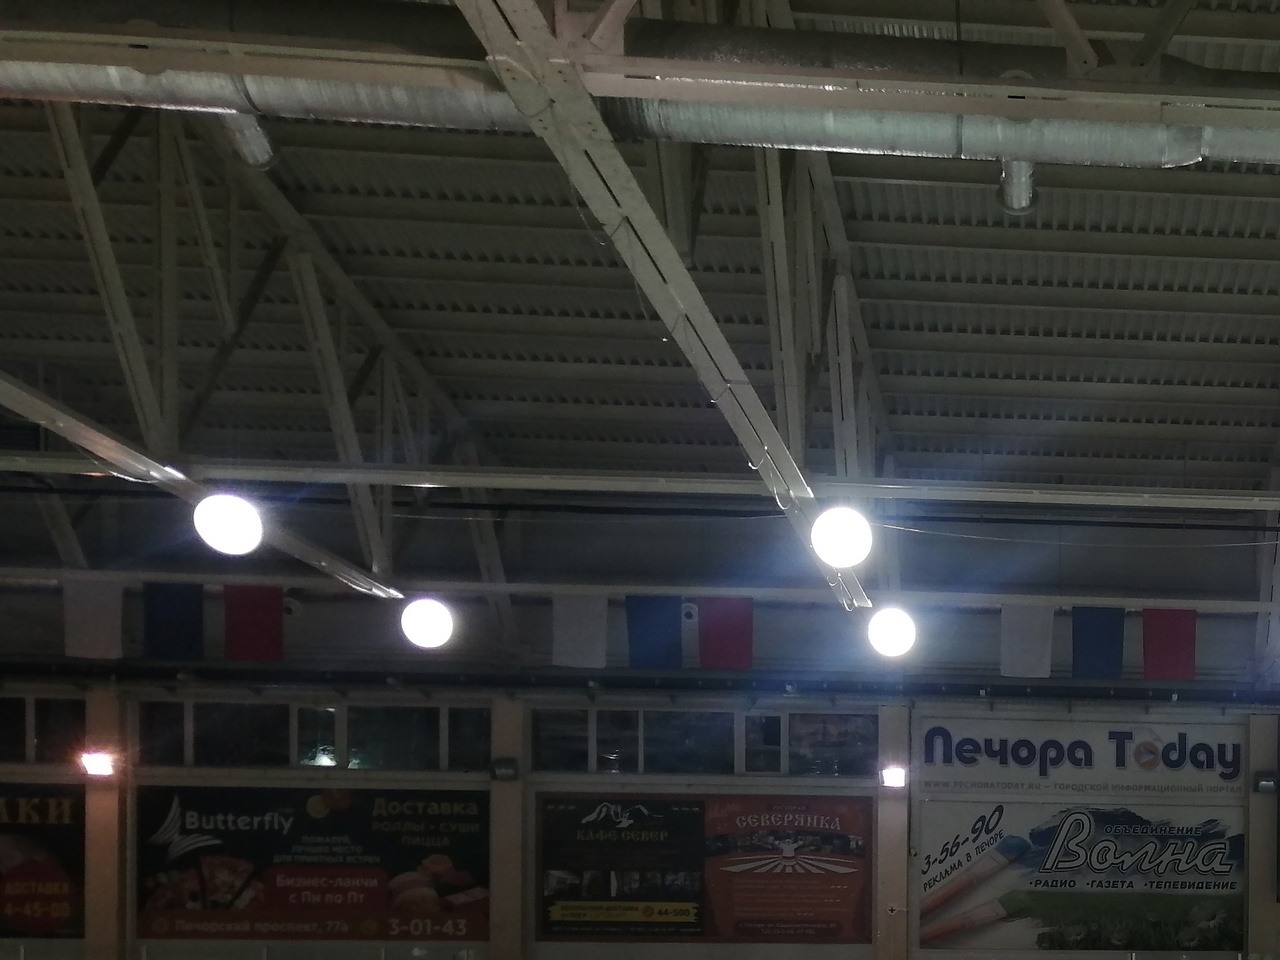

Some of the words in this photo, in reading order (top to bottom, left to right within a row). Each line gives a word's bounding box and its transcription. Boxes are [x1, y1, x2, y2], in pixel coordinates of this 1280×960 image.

[923, 725, 1094, 777] Печора
[372, 798, 479, 817] Доставка
[185, 810, 295, 836] Butterfly
[735, 813, 842, 831] СЕВЕРЯНКА
[1104, 825, 1203, 836] ОБЪЕДИНЕНИЕ
[921, 804, 1004, 875] 3-56-90
[1038, 811, 1235, 877] Волна
[923, 859, 963, 892] РЕКЛАМА
[965, 852, 972, 863] В
[974, 829, 1004, 856] ПЕЧОРЕ
[276, 874, 379, 888] Бизнес-ланчи
[1034, 879, 1077, 889] РАДИО
[1089, 880, 1135, 889] ГАЗЕТА
[1147, 881, 1238, 891] ТЕЛЕВИДЕНИЕ
[656, 908, 690, 917] 44-500
[388, 918, 468, 936] 3-01-43
